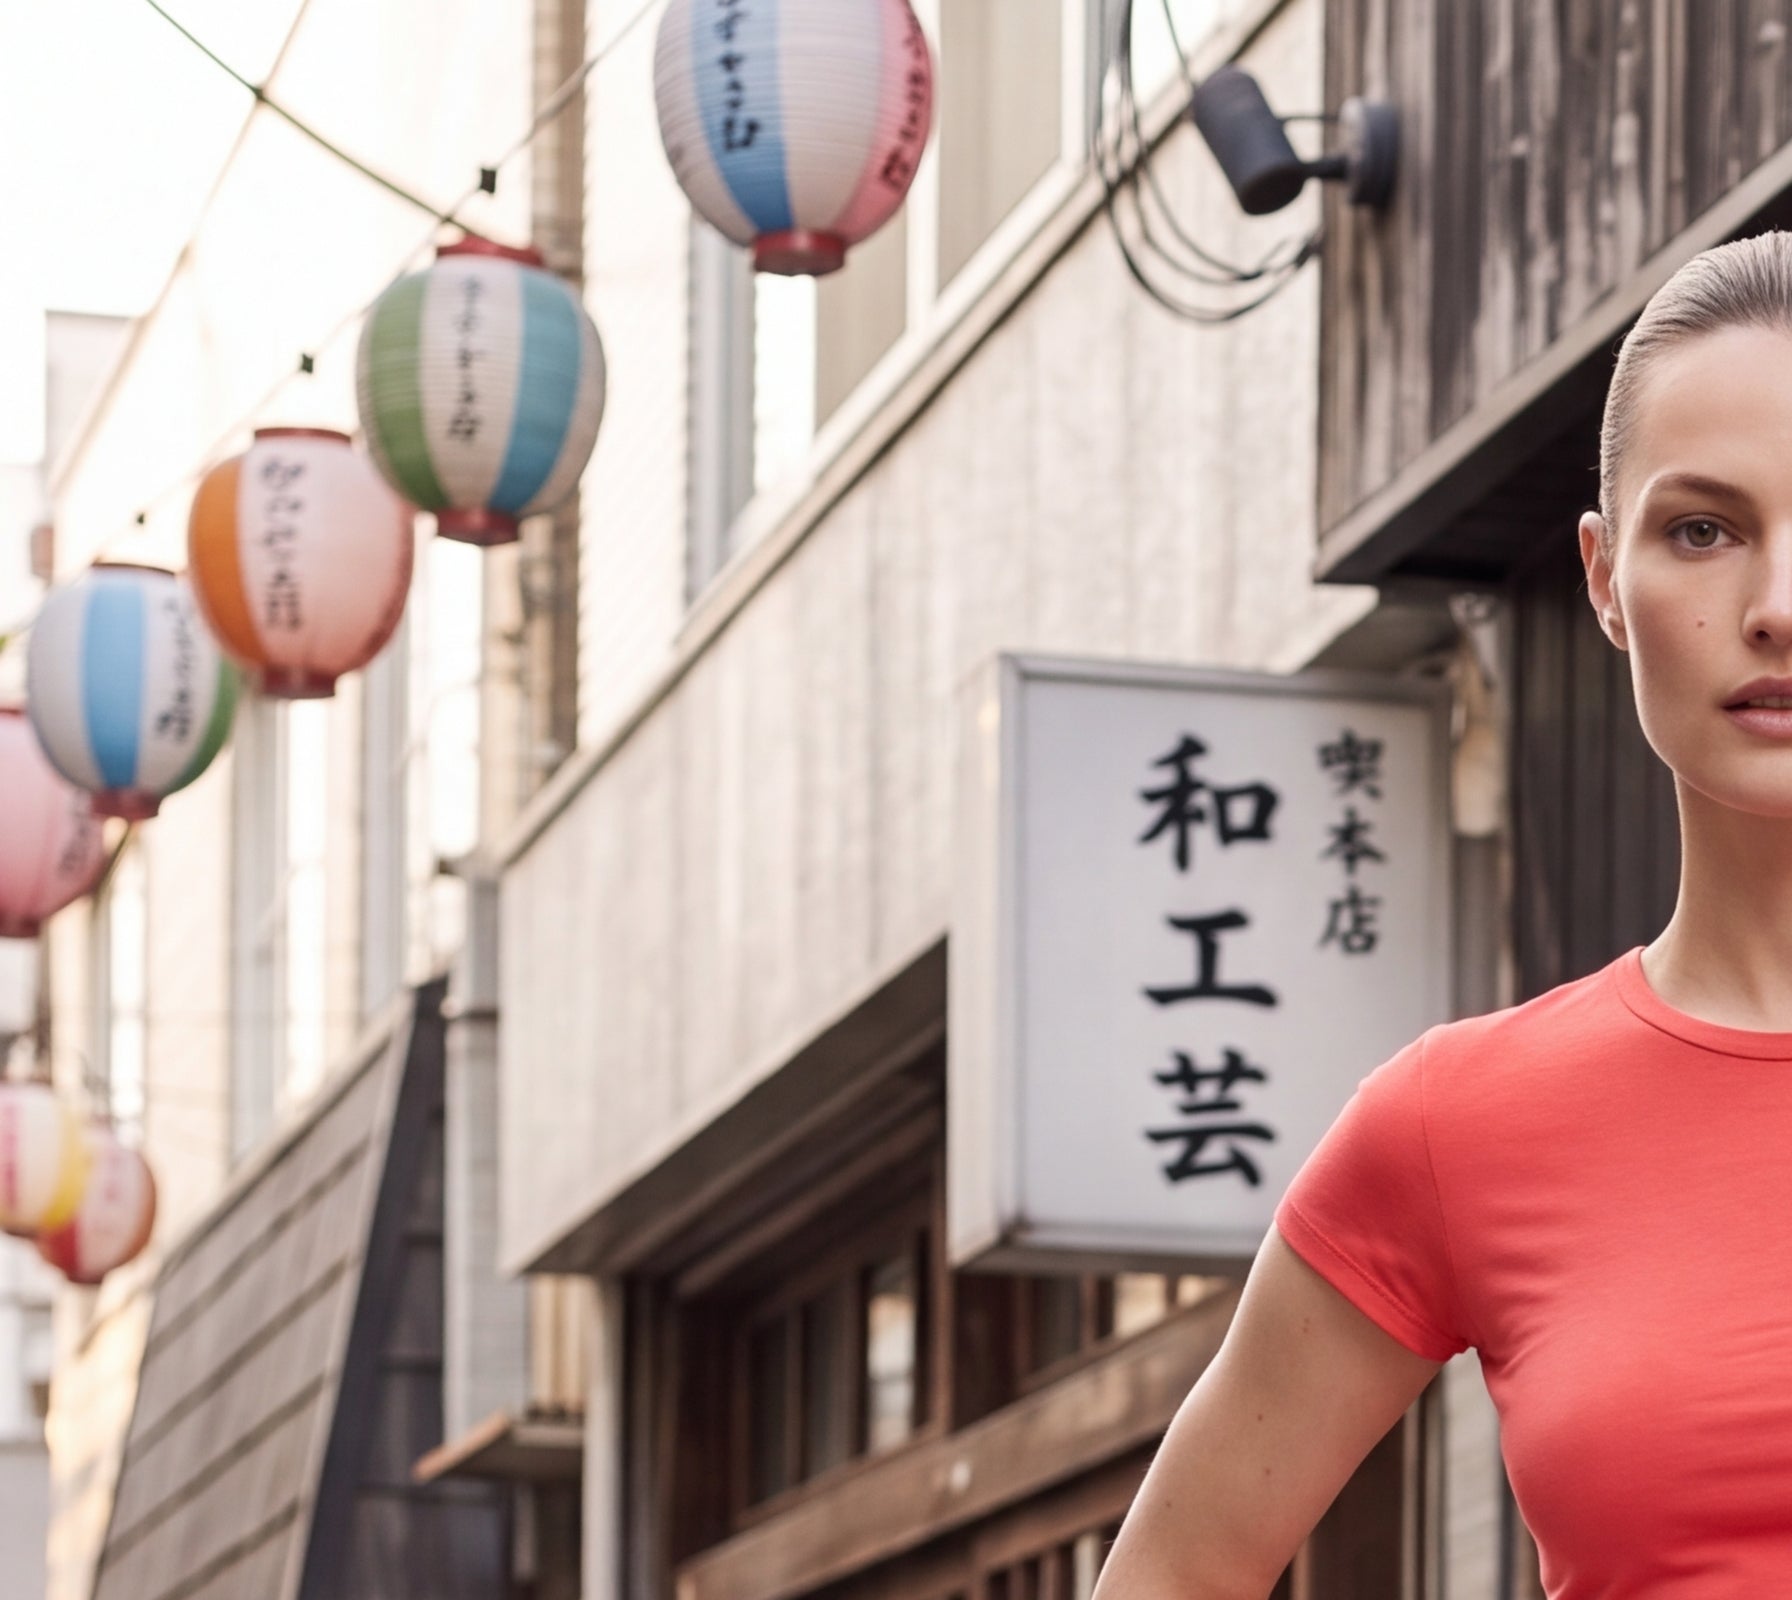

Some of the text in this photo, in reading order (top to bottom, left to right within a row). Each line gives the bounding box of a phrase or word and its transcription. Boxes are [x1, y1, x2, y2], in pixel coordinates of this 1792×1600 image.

[1138, 733, 1282, 1190] 和工芸
[1315, 729, 1387, 956] 喫本店
